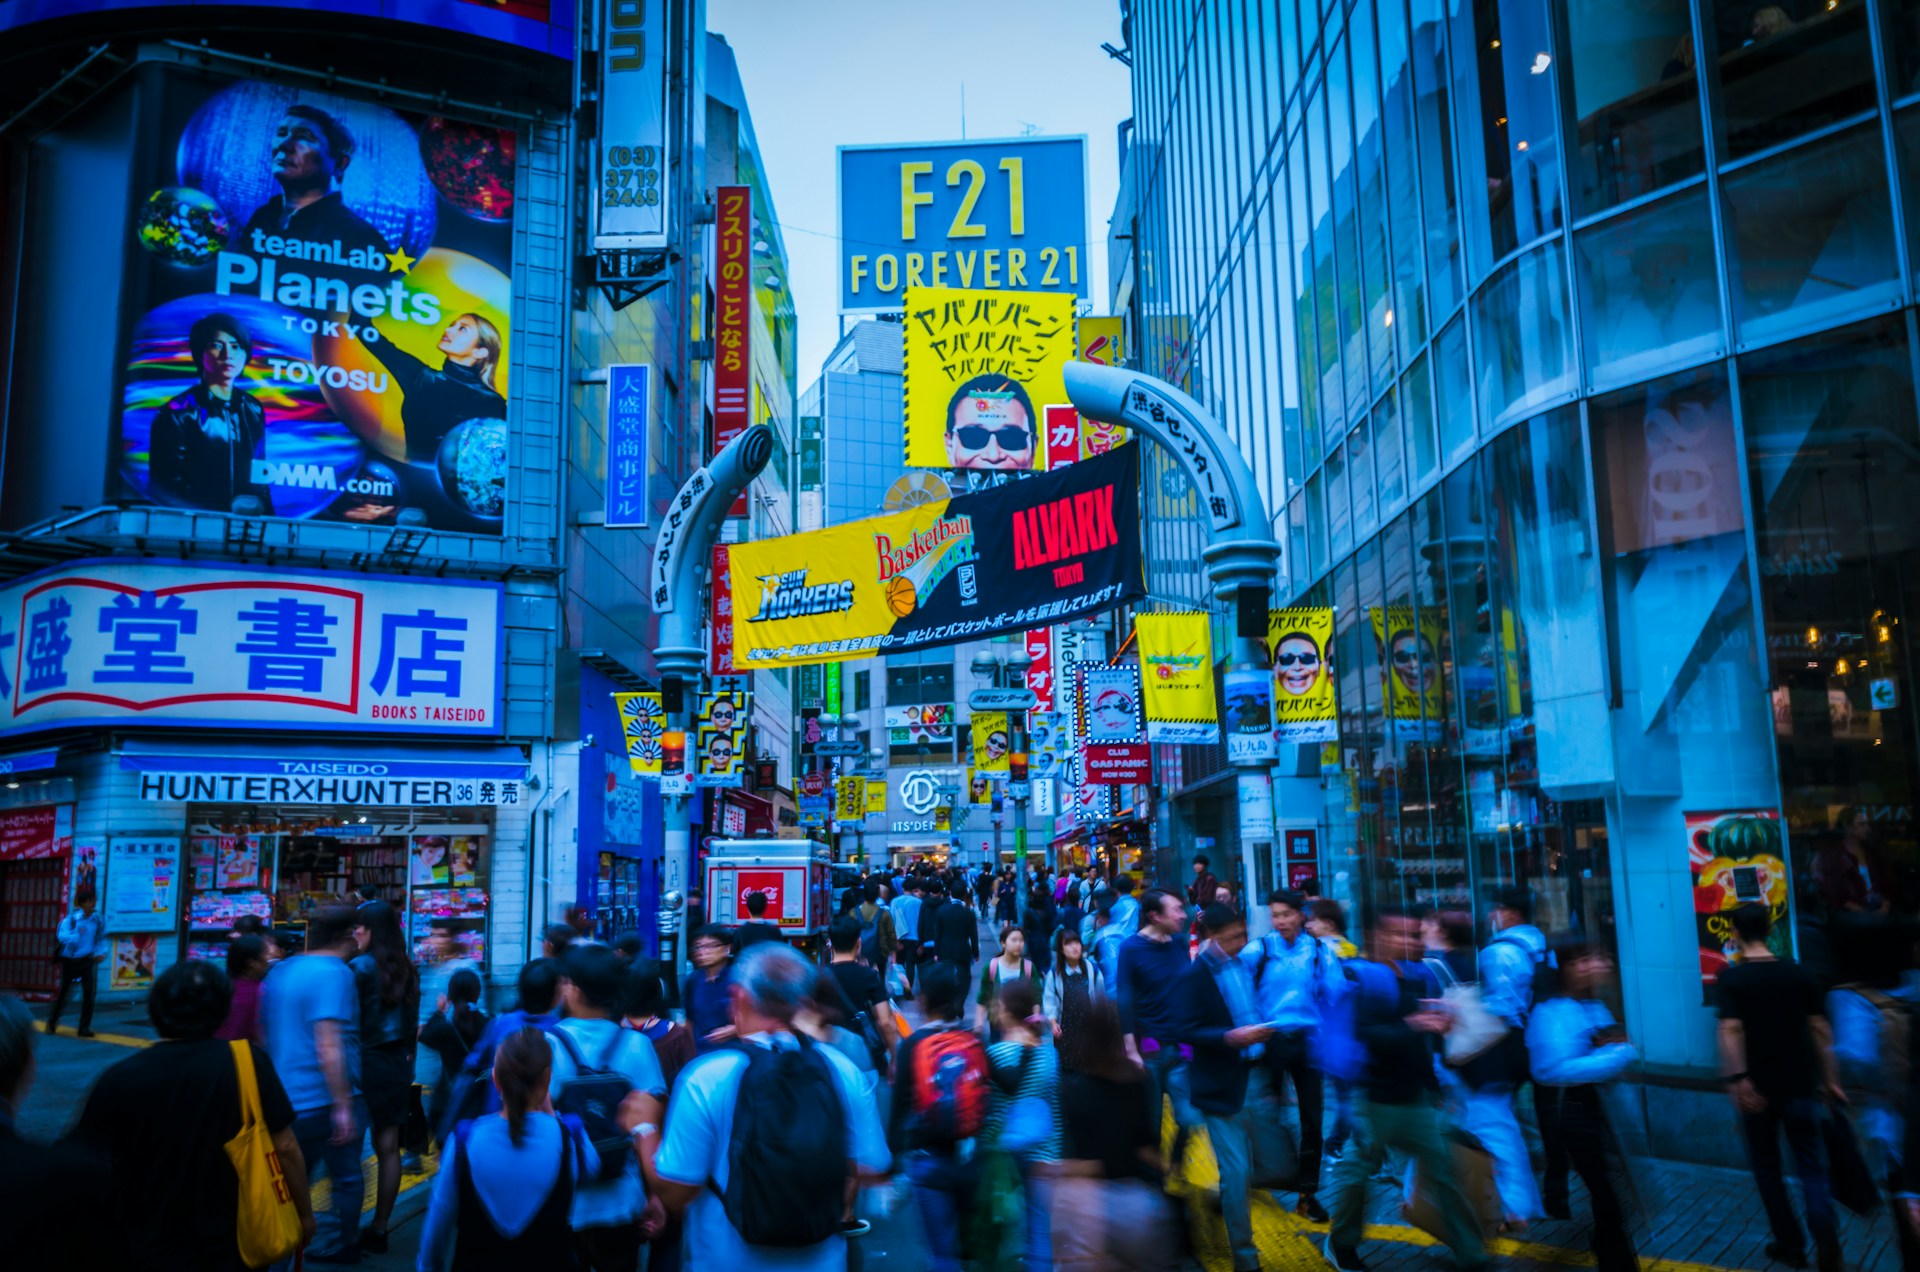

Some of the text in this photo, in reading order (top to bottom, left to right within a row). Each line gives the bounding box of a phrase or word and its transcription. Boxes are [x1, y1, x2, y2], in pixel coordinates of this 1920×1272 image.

[608, 145, 656, 167] (03)
[605, 169, 659, 188] 3719
[604, 188, 660, 207] 2468
[901, 157, 1025, 240] F21
[250, 227, 387, 272] teamLab
[721, 195, 745, 372] クスリのことなら
[851, 245, 1079, 294] FOREVER 21
[215, 250, 442, 326] Planets
[282, 315, 380, 343] TOKYO
[913, 298, 1067, 339] ヤバババーン
[929, 331, 1051, 363] ヤバババーン
[268, 358, 388, 394] TOYOSU
[942, 357, 1040, 384] ヤバババーン
[615, 374, 641, 517] 大盛堂商事ビル
[1132, 391, 1228, 519] 渋谷センター街
[250, 458, 394, 497] DMM.com
[655, 475, 706, 609] 渋谷センター街
[1012, 483, 1119, 571] ALVARK
[874, 516, 972, 582] Basketball
[780, 569, 809, 589] SUN
[1052, 561, 1085, 589] TOKYO
[747, 574, 856, 622] ROCKERS
[1269, 614, 1330, 631] バババーン
[1028, 627, 1051, 713] ラオケ
[371, 704, 486, 723] BOOKS TAISEIDO
[973, 692, 1033, 704] 渋谷センター街
[278, 762, 390, 776] TAISEIDO
[1090, 759, 1148, 769] GAS PANIC
[1107, 748, 1130, 756] CLUB
[457, 784, 474, 802] 36
